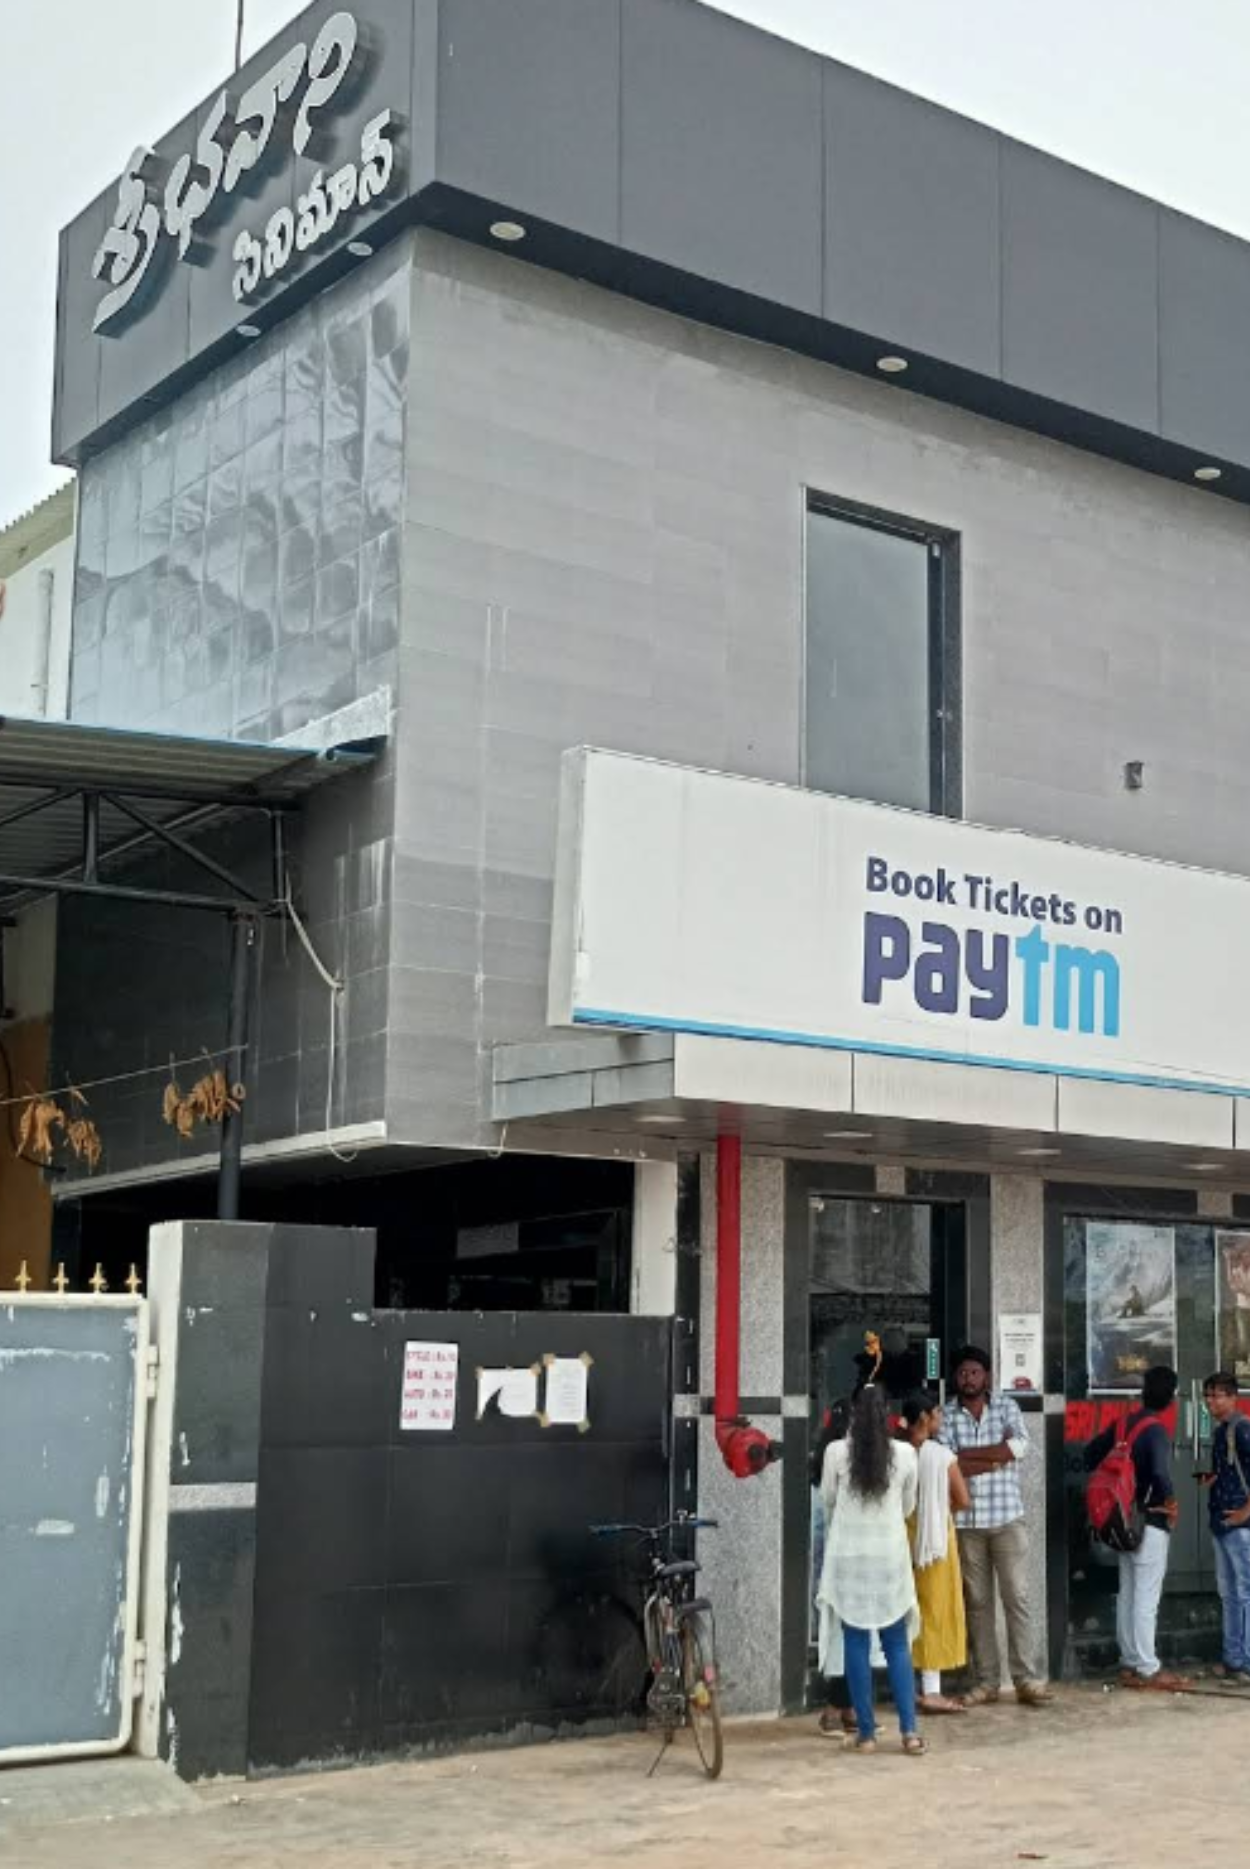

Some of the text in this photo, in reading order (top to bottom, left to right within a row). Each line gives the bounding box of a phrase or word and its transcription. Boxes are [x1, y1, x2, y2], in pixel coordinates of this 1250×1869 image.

[866, 856, 1123, 934] Book Tickets on
